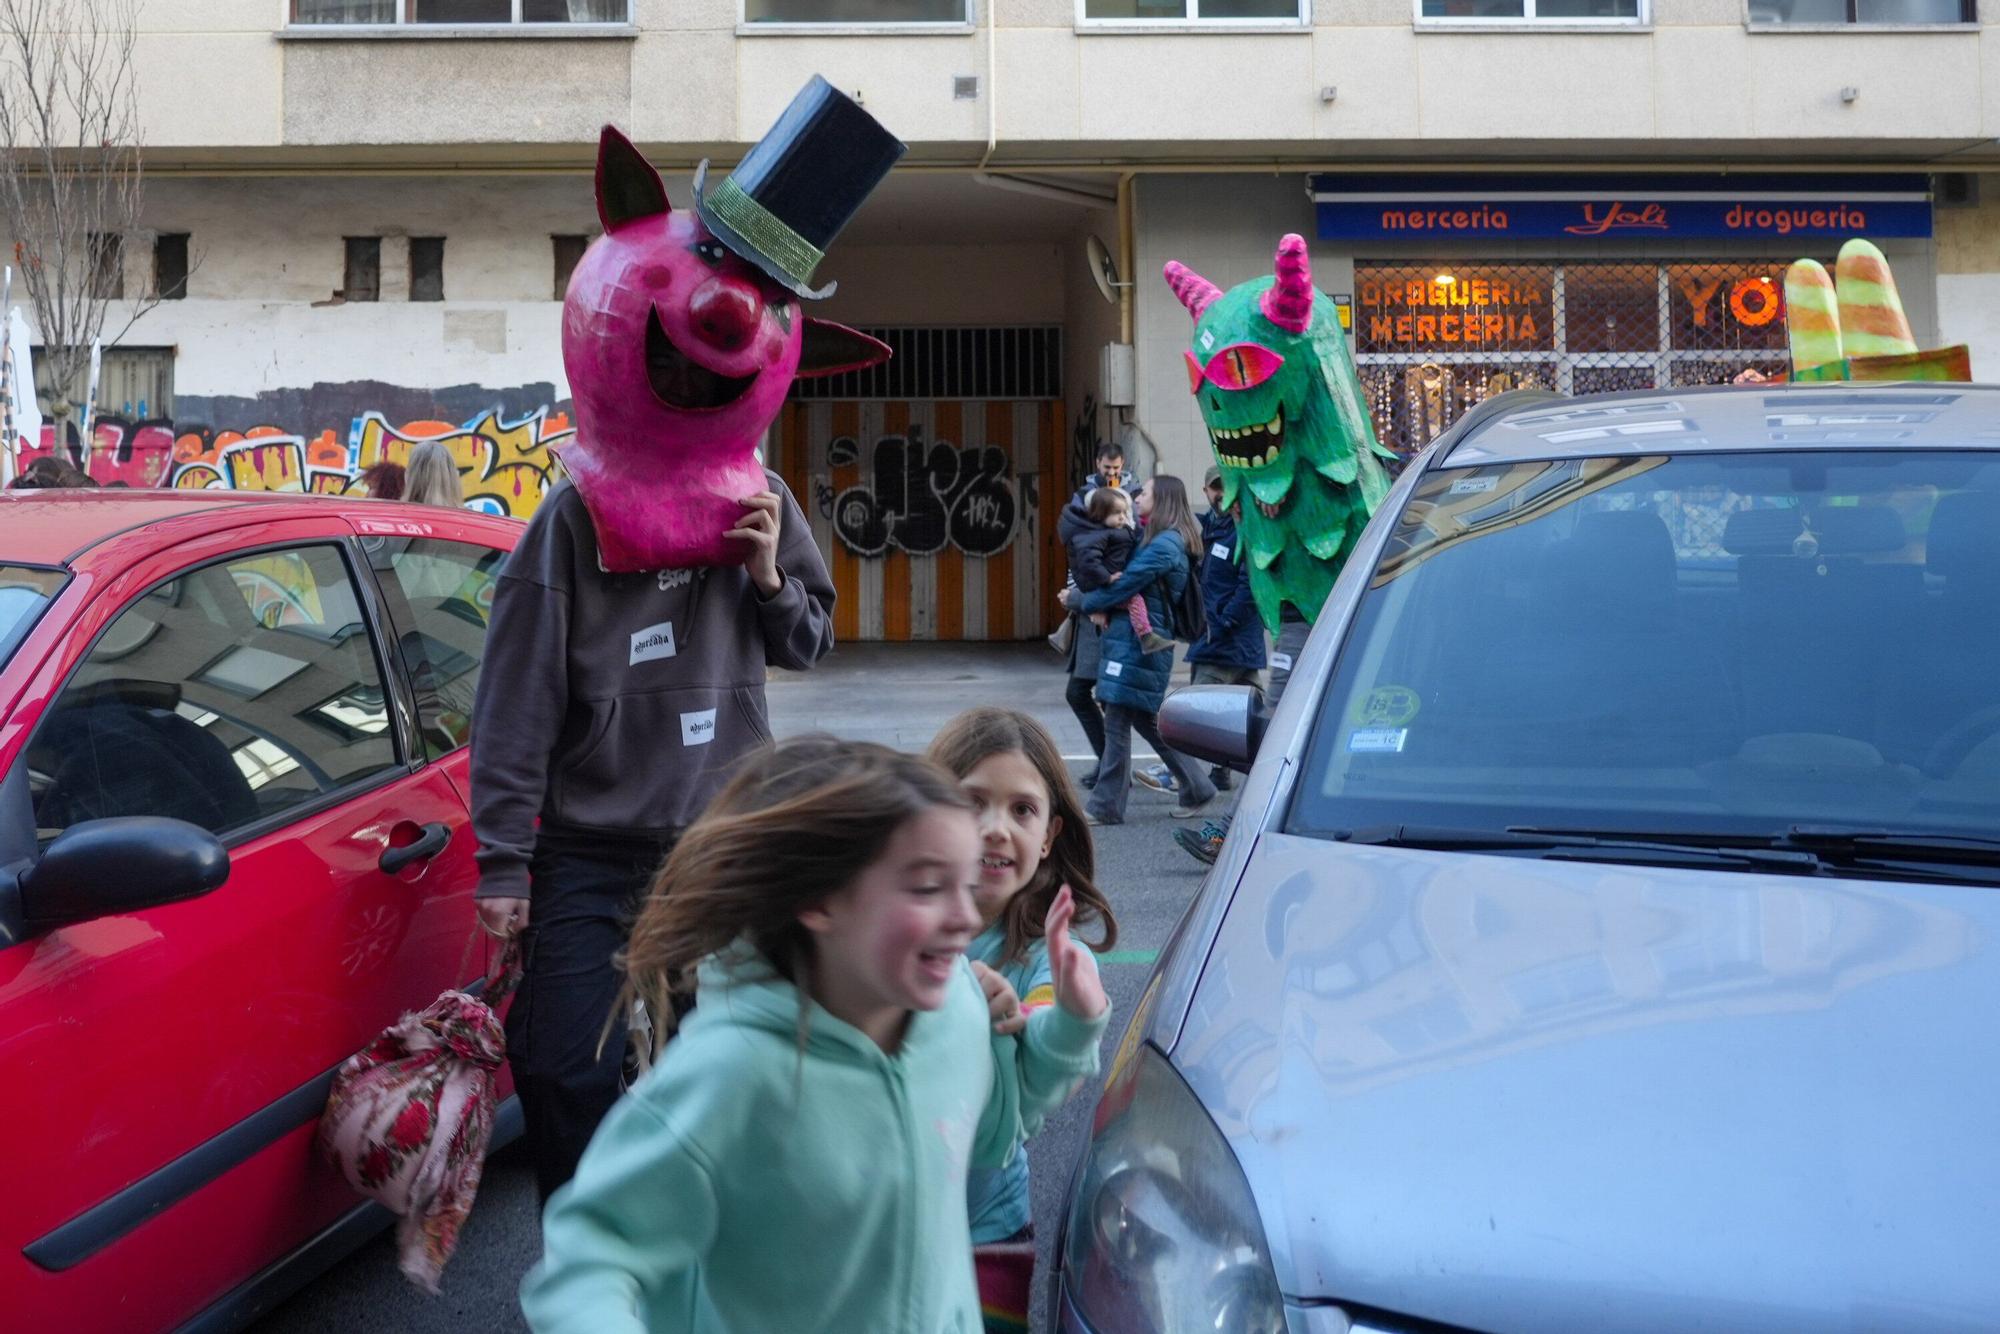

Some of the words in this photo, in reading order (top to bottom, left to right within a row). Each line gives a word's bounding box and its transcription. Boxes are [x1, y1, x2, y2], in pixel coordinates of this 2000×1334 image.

[1382, 204, 1508, 229] merceria
[1563, 201, 1669, 234] Yoli
[1725, 204, 1866, 233] drogueria
[1370, 313, 1538, 342] MERCERIA
